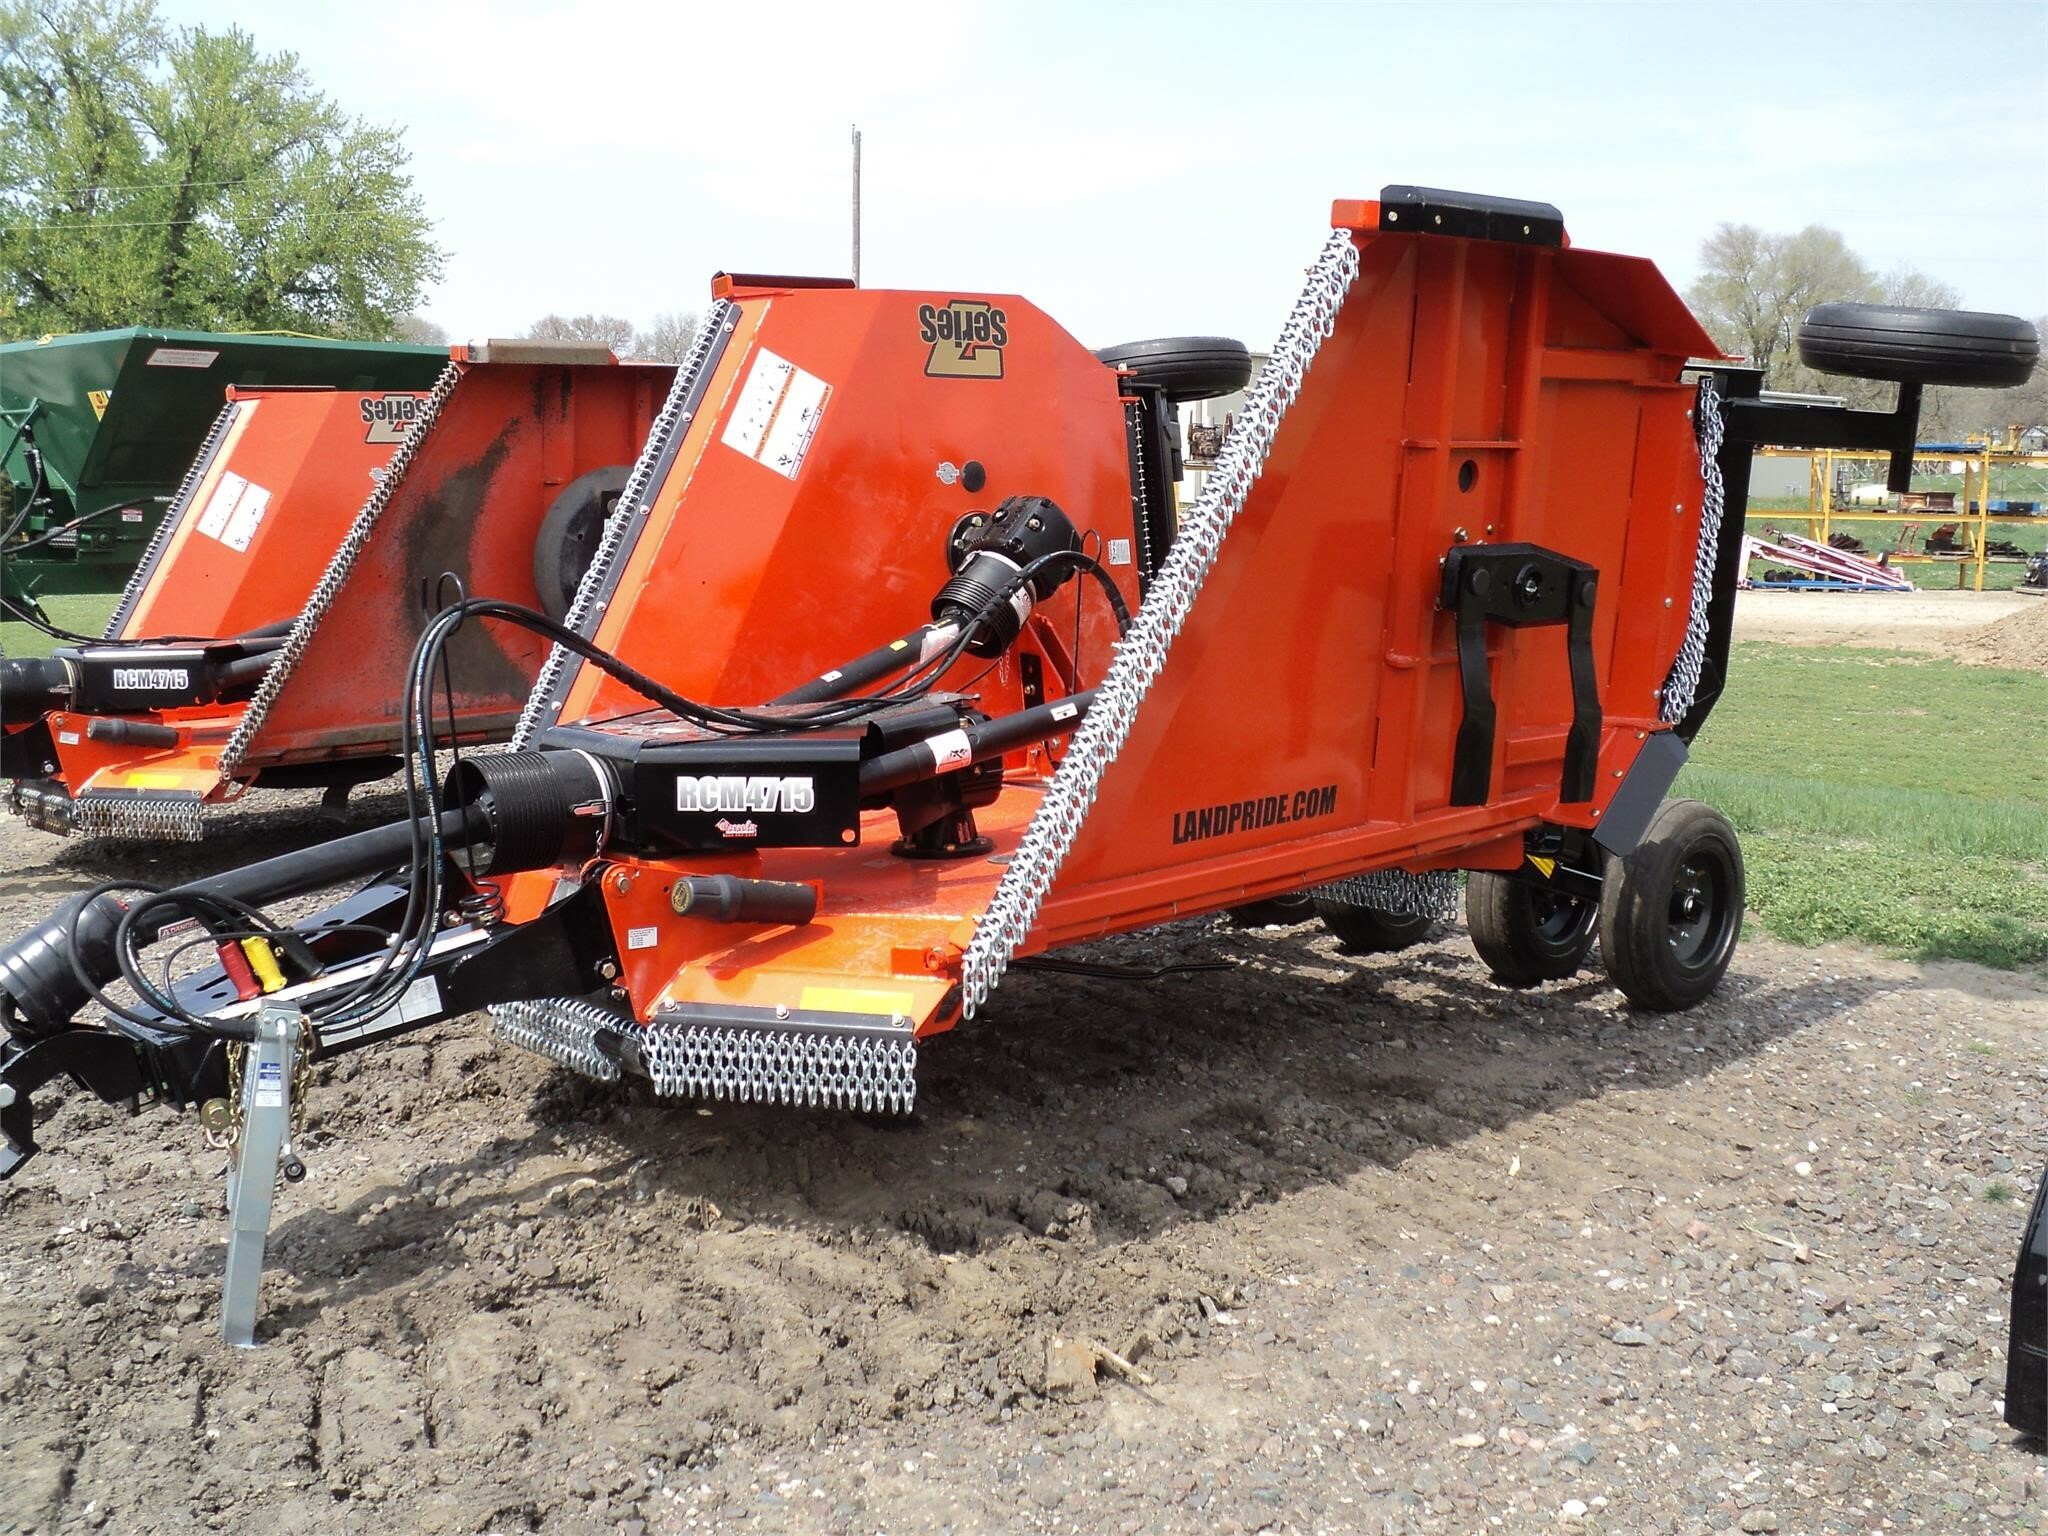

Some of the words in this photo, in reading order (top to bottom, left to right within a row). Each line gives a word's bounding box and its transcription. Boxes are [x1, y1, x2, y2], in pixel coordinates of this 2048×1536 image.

[919, 304, 1008, 348] Series
[113, 669, 189, 690] RCM4715
[677, 776, 814, 812] RCM4715
[1173, 785, 1337, 845] LANDPRIDE.COM
